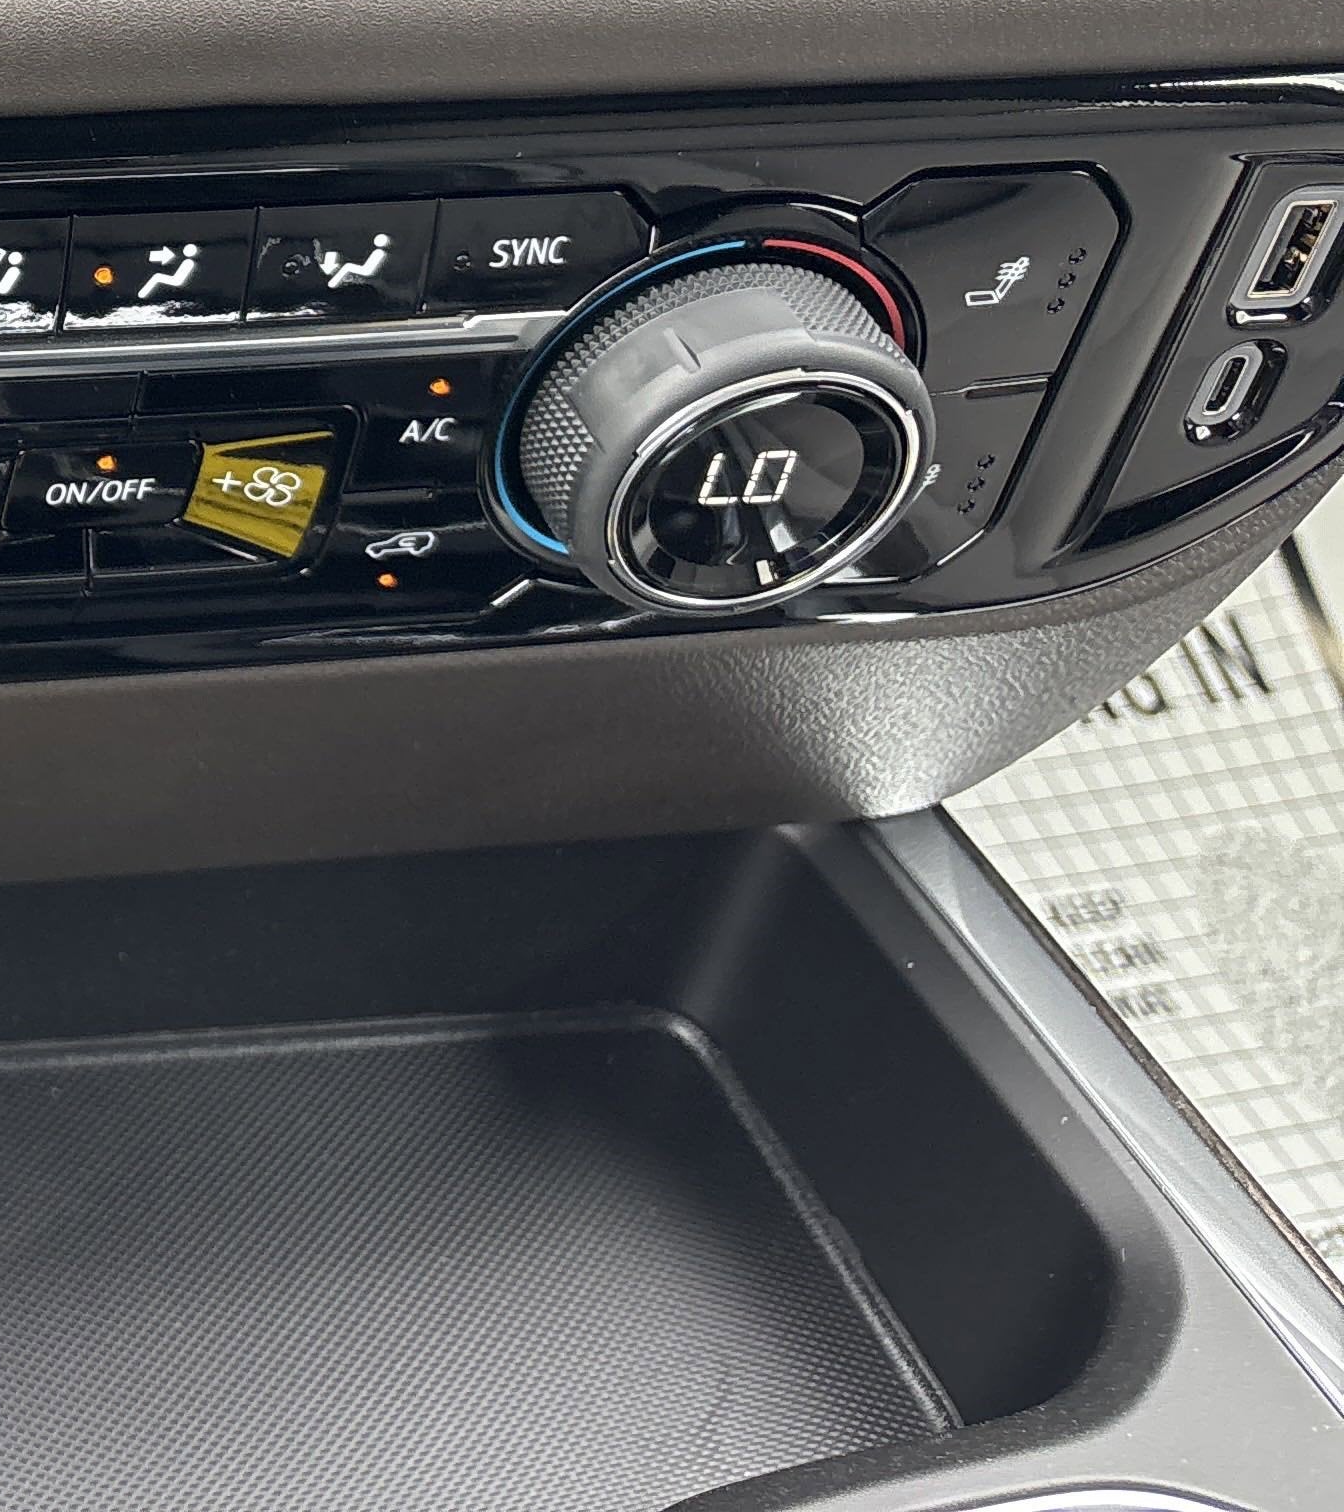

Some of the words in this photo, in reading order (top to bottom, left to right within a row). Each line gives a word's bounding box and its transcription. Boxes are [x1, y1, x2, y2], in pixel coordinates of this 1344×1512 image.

[488, 235, 571, 269] SYNC
[398, 416, 456, 443] A/C
[45, 476, 157, 507] ON/OFF
